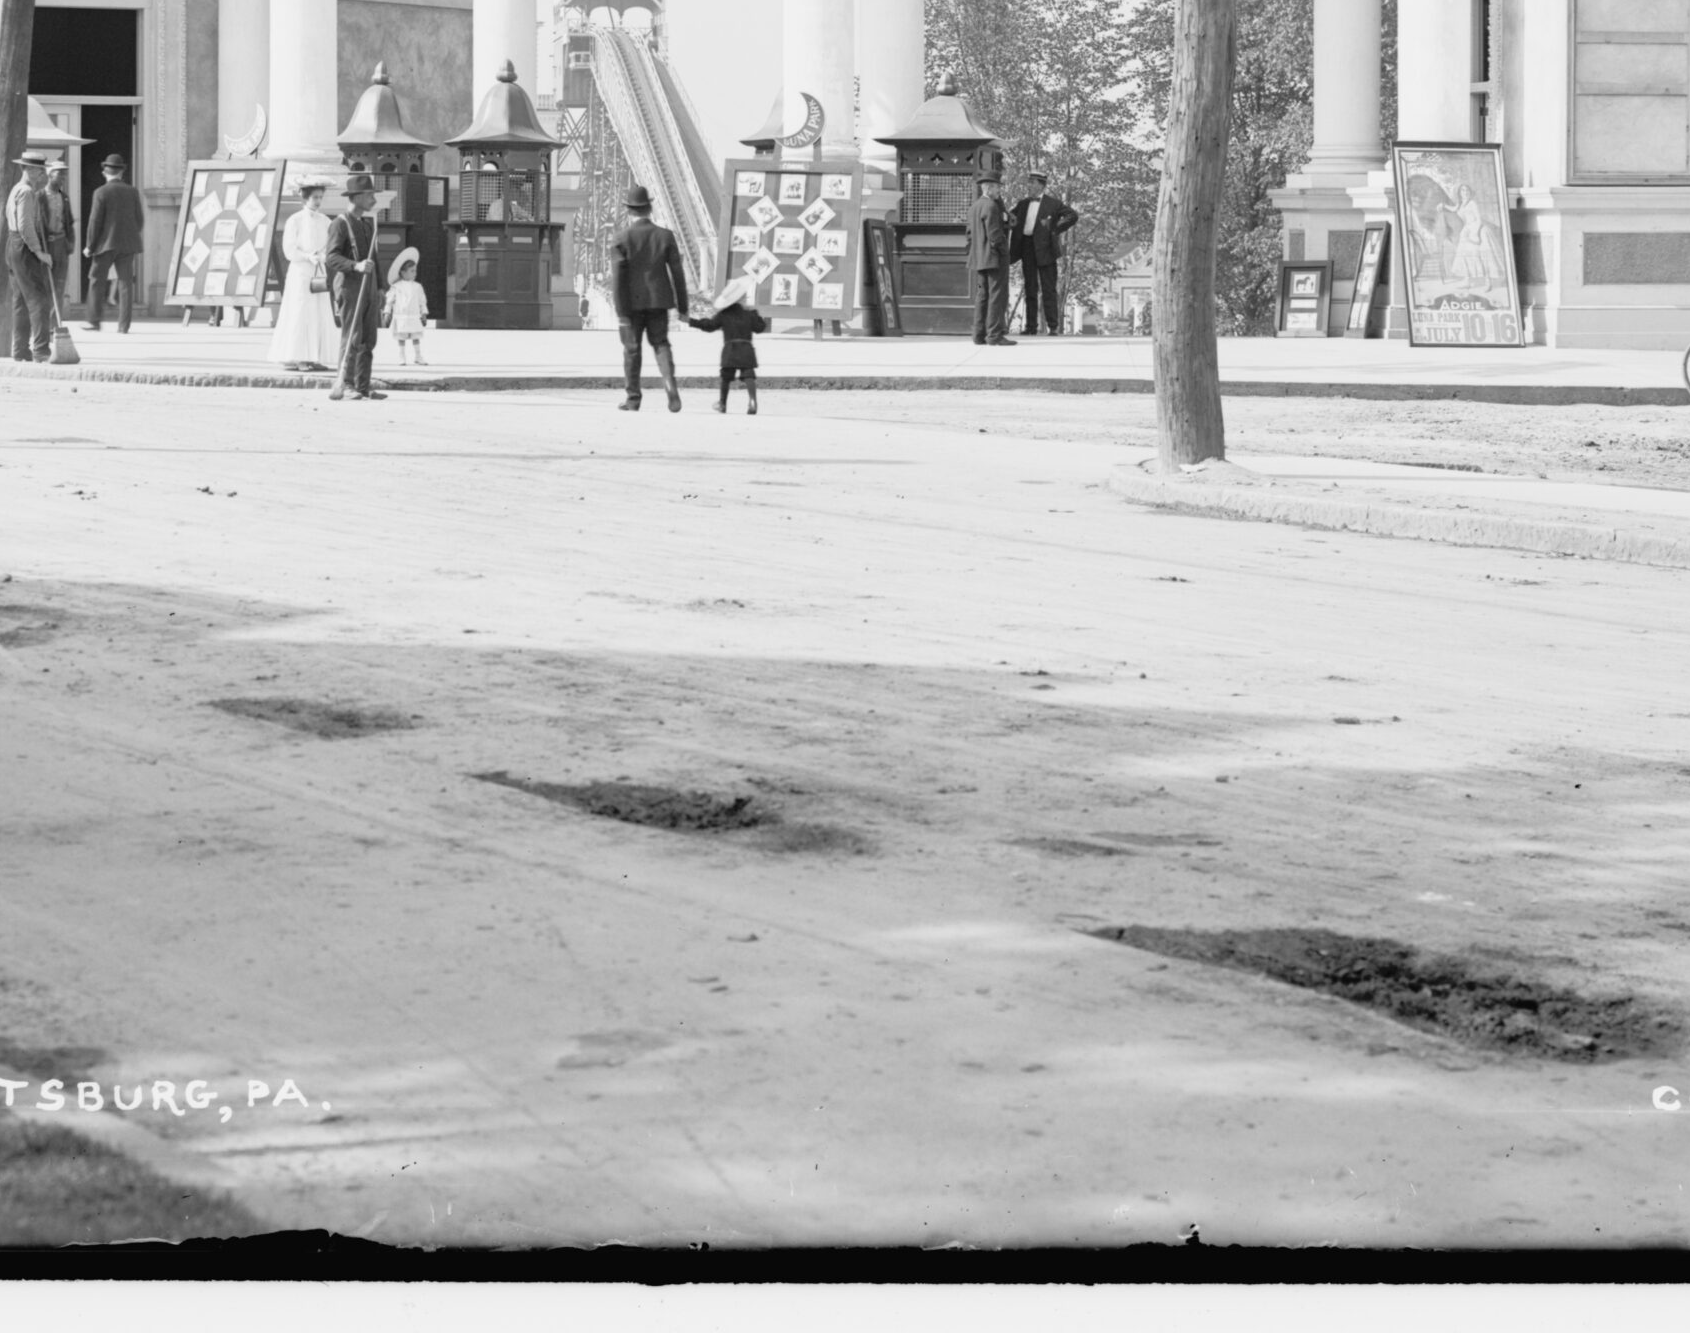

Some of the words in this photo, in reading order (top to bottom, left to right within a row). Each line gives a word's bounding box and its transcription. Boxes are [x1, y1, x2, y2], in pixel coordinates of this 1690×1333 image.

[783, 128, 815, 146] LUNA
[1440, 299, 1486, 310] ADGIE
[1413, 312, 1434, 323] LUNA
[1437, 312, 1461, 323] PARK
[1462, 313, 1487, 343] 10
[1423, 327, 1461, 343] JULY
[1491, 313, 1518, 343] 16
